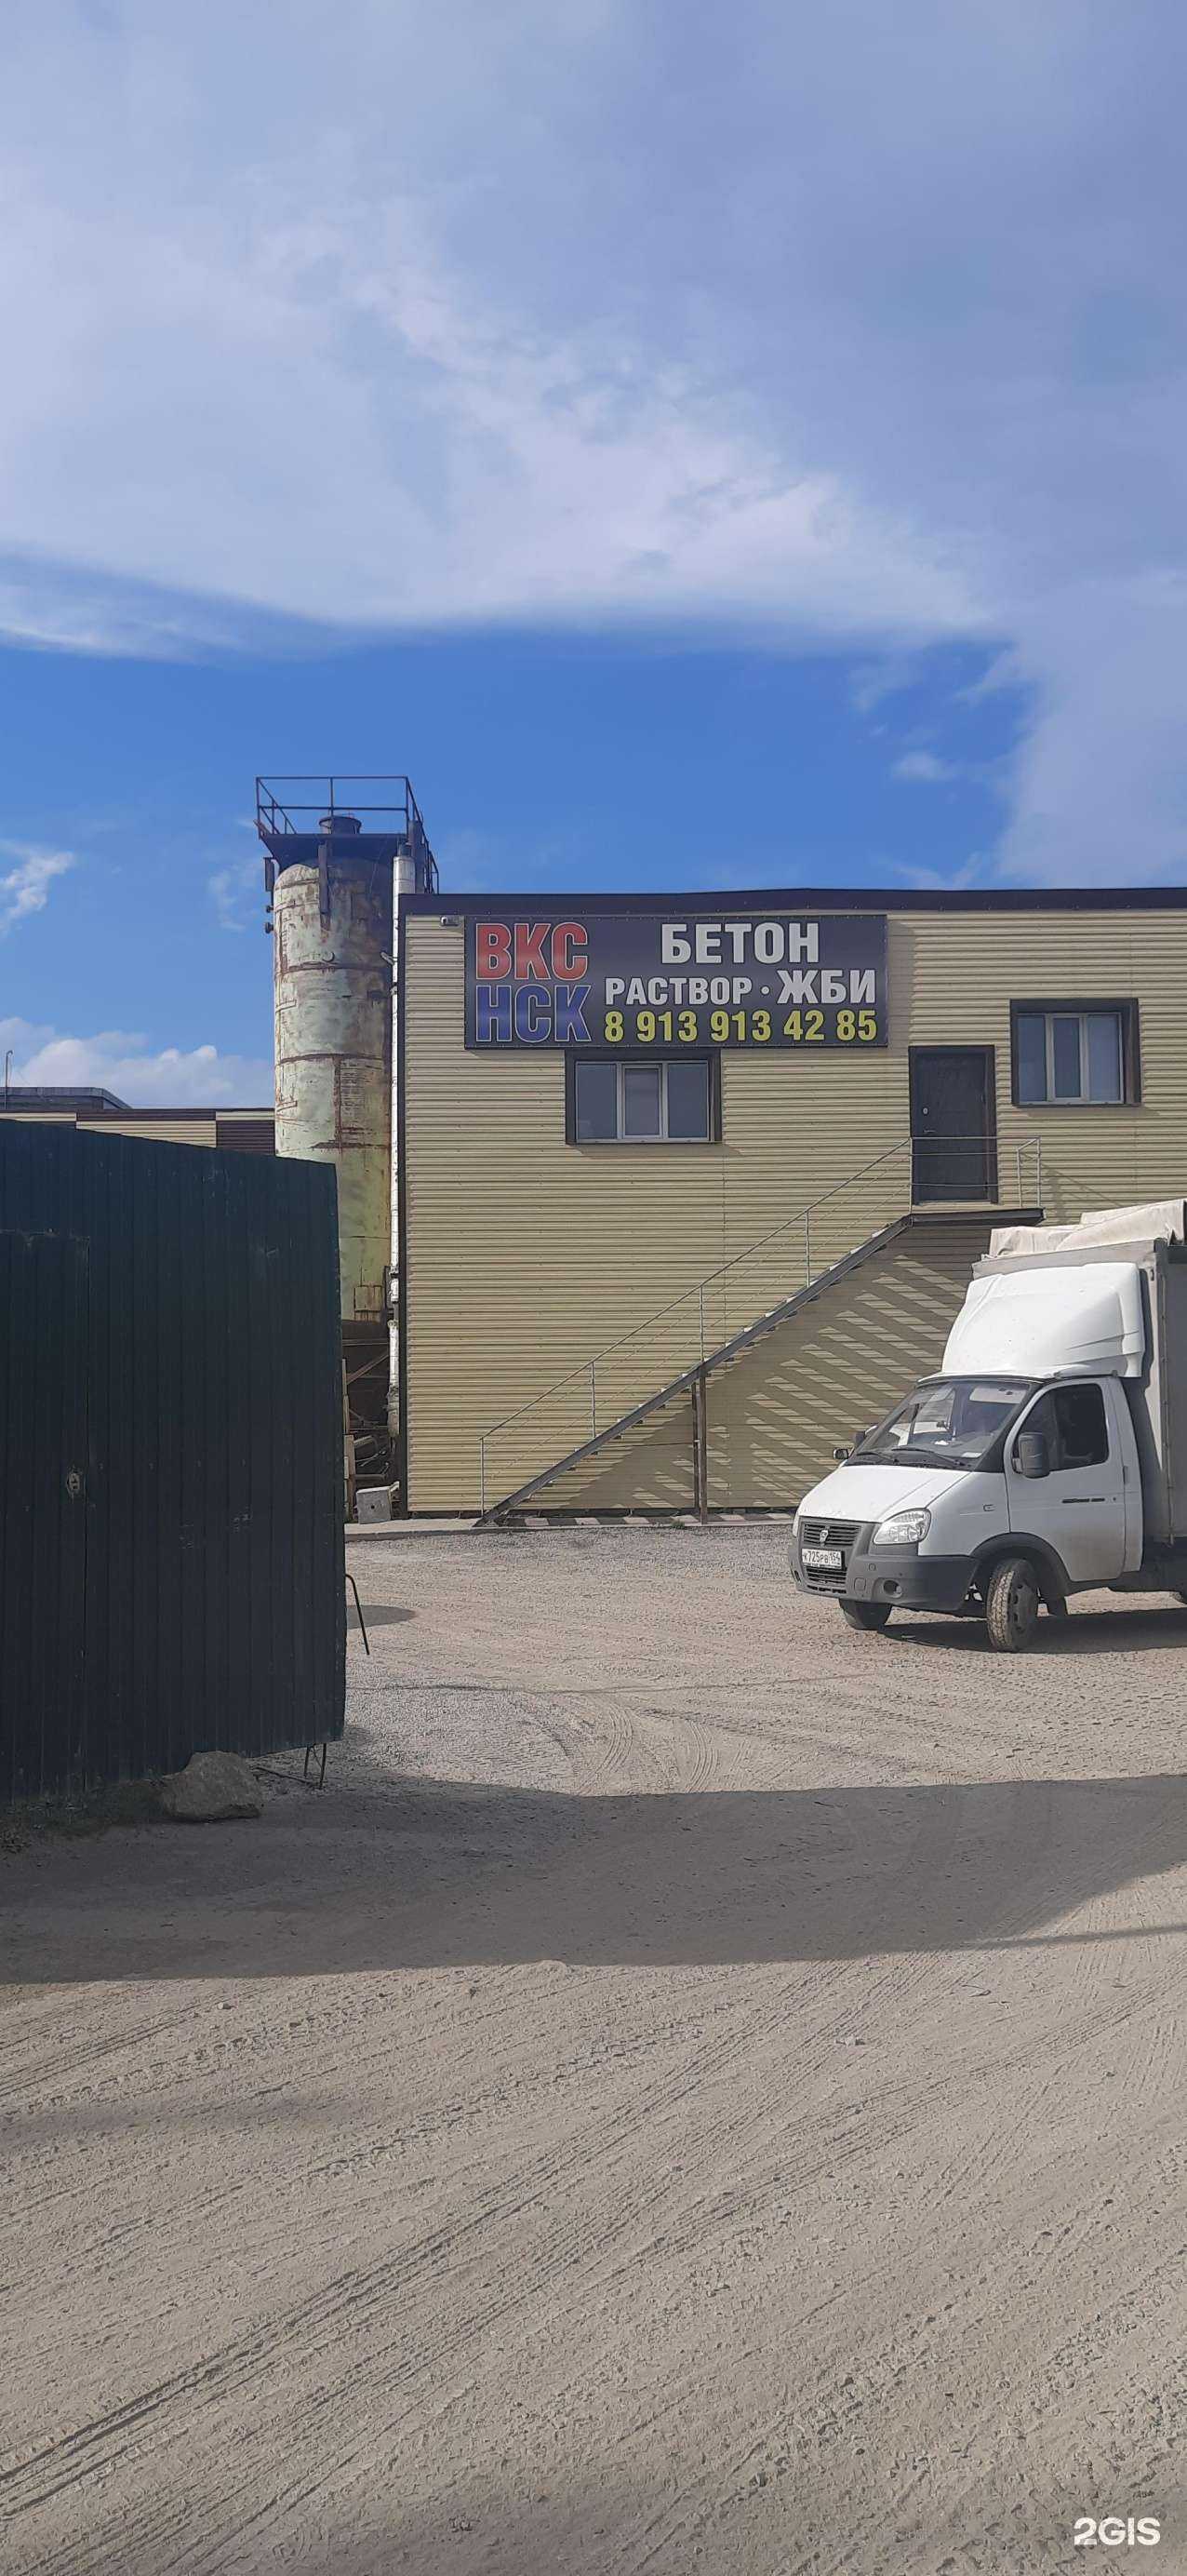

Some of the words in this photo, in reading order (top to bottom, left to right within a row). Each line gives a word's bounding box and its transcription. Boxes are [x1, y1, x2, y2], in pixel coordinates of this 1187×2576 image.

[475, 922, 588, 980] ВКС
[661, 922, 820, 964] БЕТОН
[605, 976, 752, 1005] РАСТВОР
[776, 969, 875, 1005] ЖБИ
[475, 985, 592, 1042] НСК
[604, 1011, 624, 1041] 8
[636, 1011, 698, 1041] 913
[711, 1011, 772, 1041] 913
[783, 1011, 825, 1041] 42
[836, 1011, 877, 1041] 85
